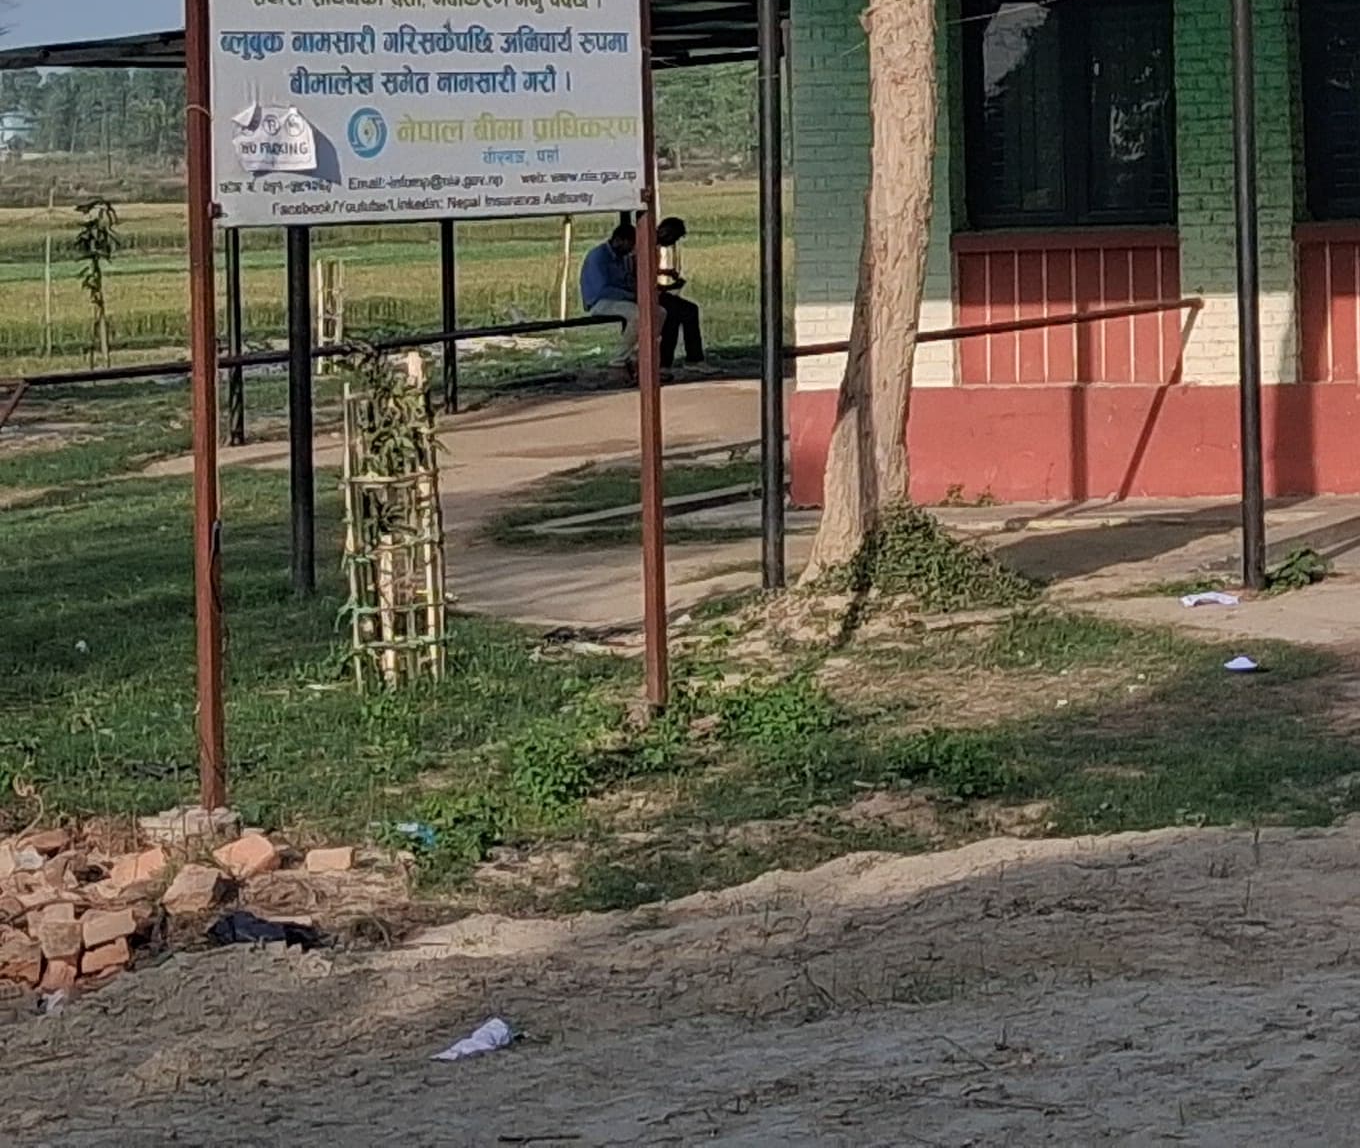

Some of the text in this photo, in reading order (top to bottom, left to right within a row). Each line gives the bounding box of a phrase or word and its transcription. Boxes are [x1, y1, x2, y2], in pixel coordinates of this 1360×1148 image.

[291, 25, 376, 55] नामसारी
[289, 66, 374, 96] बीमालेख
[380, 65, 430, 96] समेत
